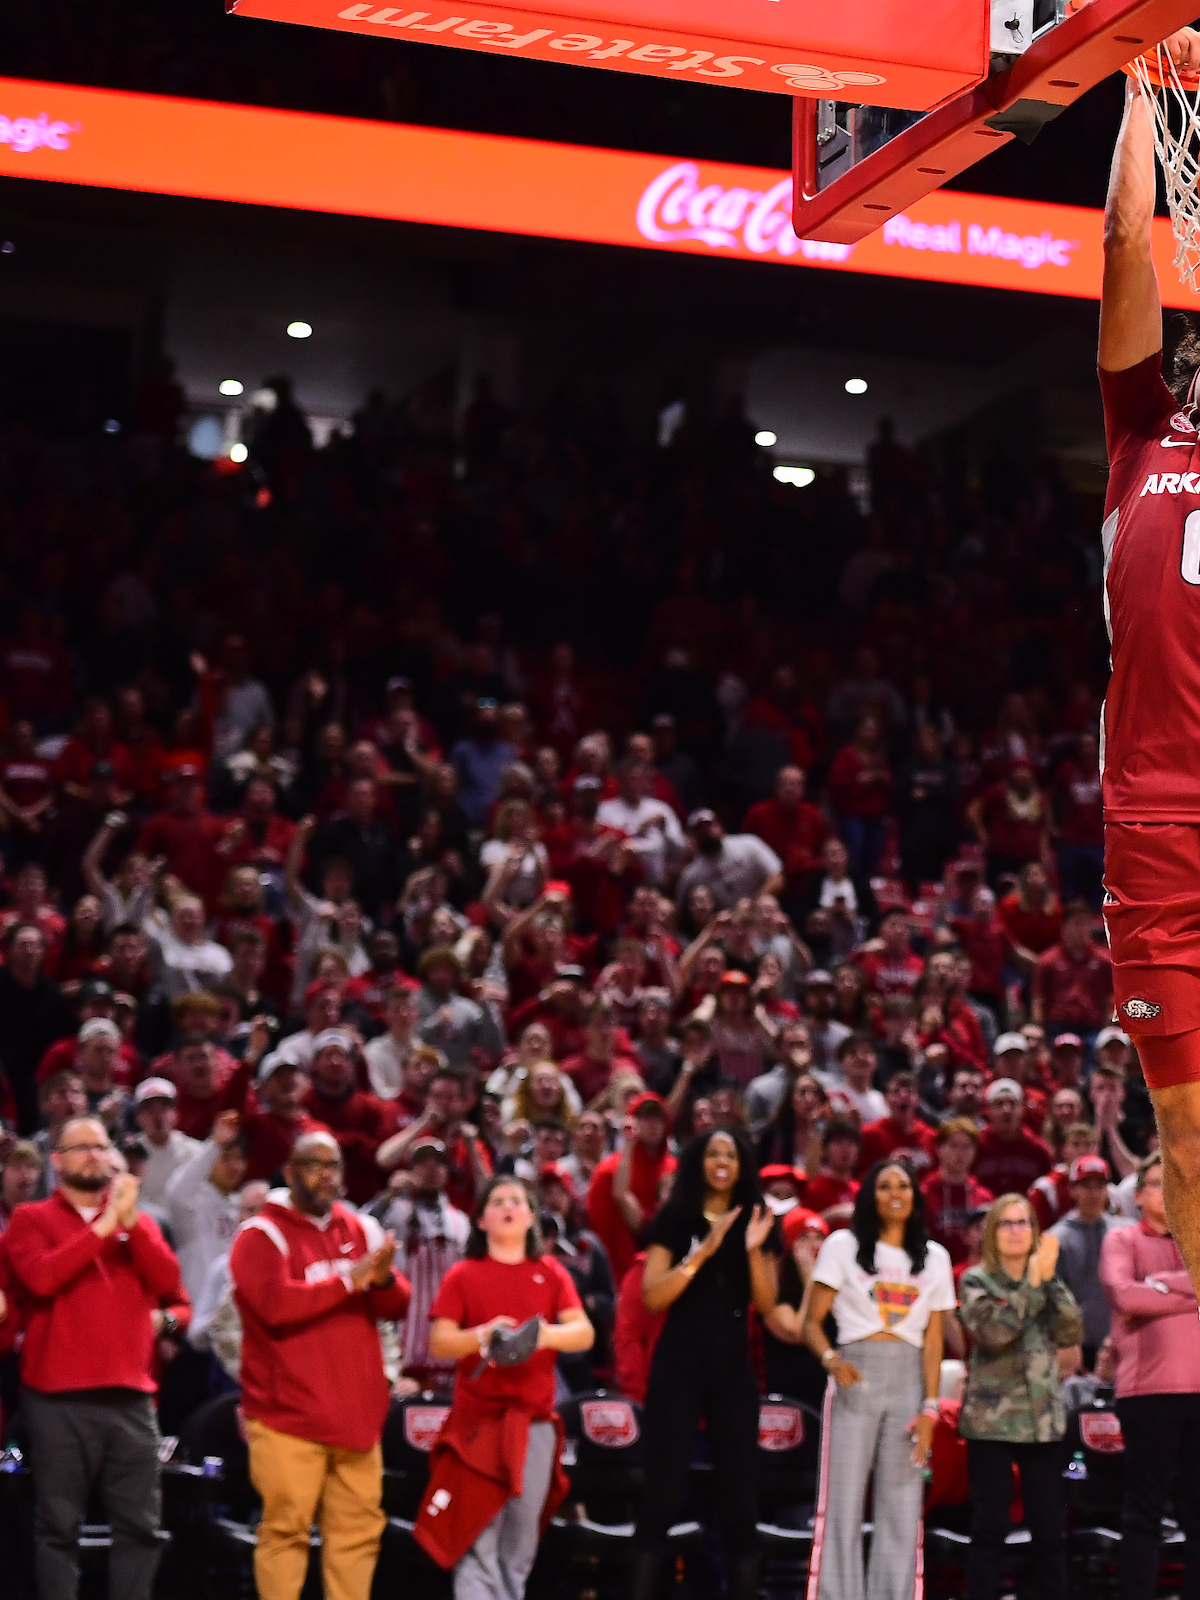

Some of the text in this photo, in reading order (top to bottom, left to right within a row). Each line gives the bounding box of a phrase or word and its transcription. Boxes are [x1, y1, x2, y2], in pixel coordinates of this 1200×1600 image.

[337, 2, 766, 79] State Farm
[883, 214, 962, 254] Real
[967, 222, 1071, 269] Magic
